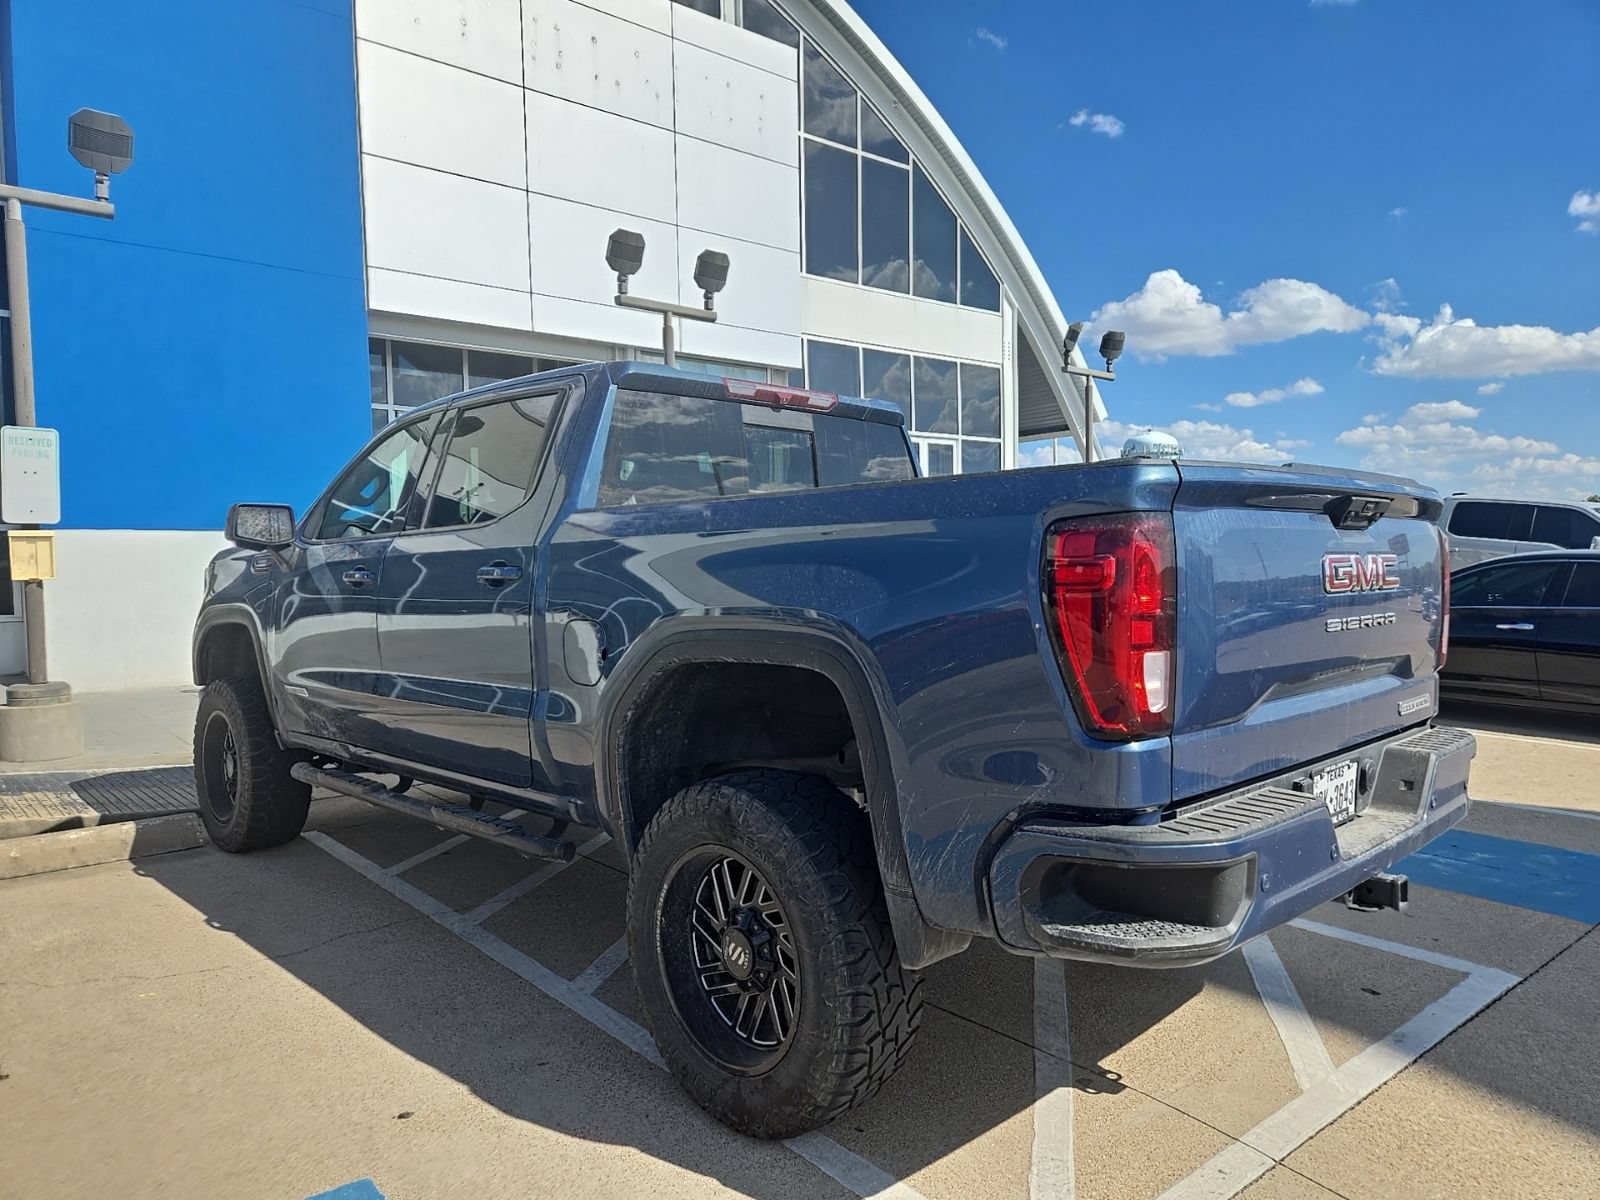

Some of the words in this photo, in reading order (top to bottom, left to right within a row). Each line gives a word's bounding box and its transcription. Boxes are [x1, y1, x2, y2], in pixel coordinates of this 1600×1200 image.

[8, 435, 53, 448] RESERVED
[1322, 553, 1400, 592] GMC
[1326, 612, 1397, 632] SIERRA
